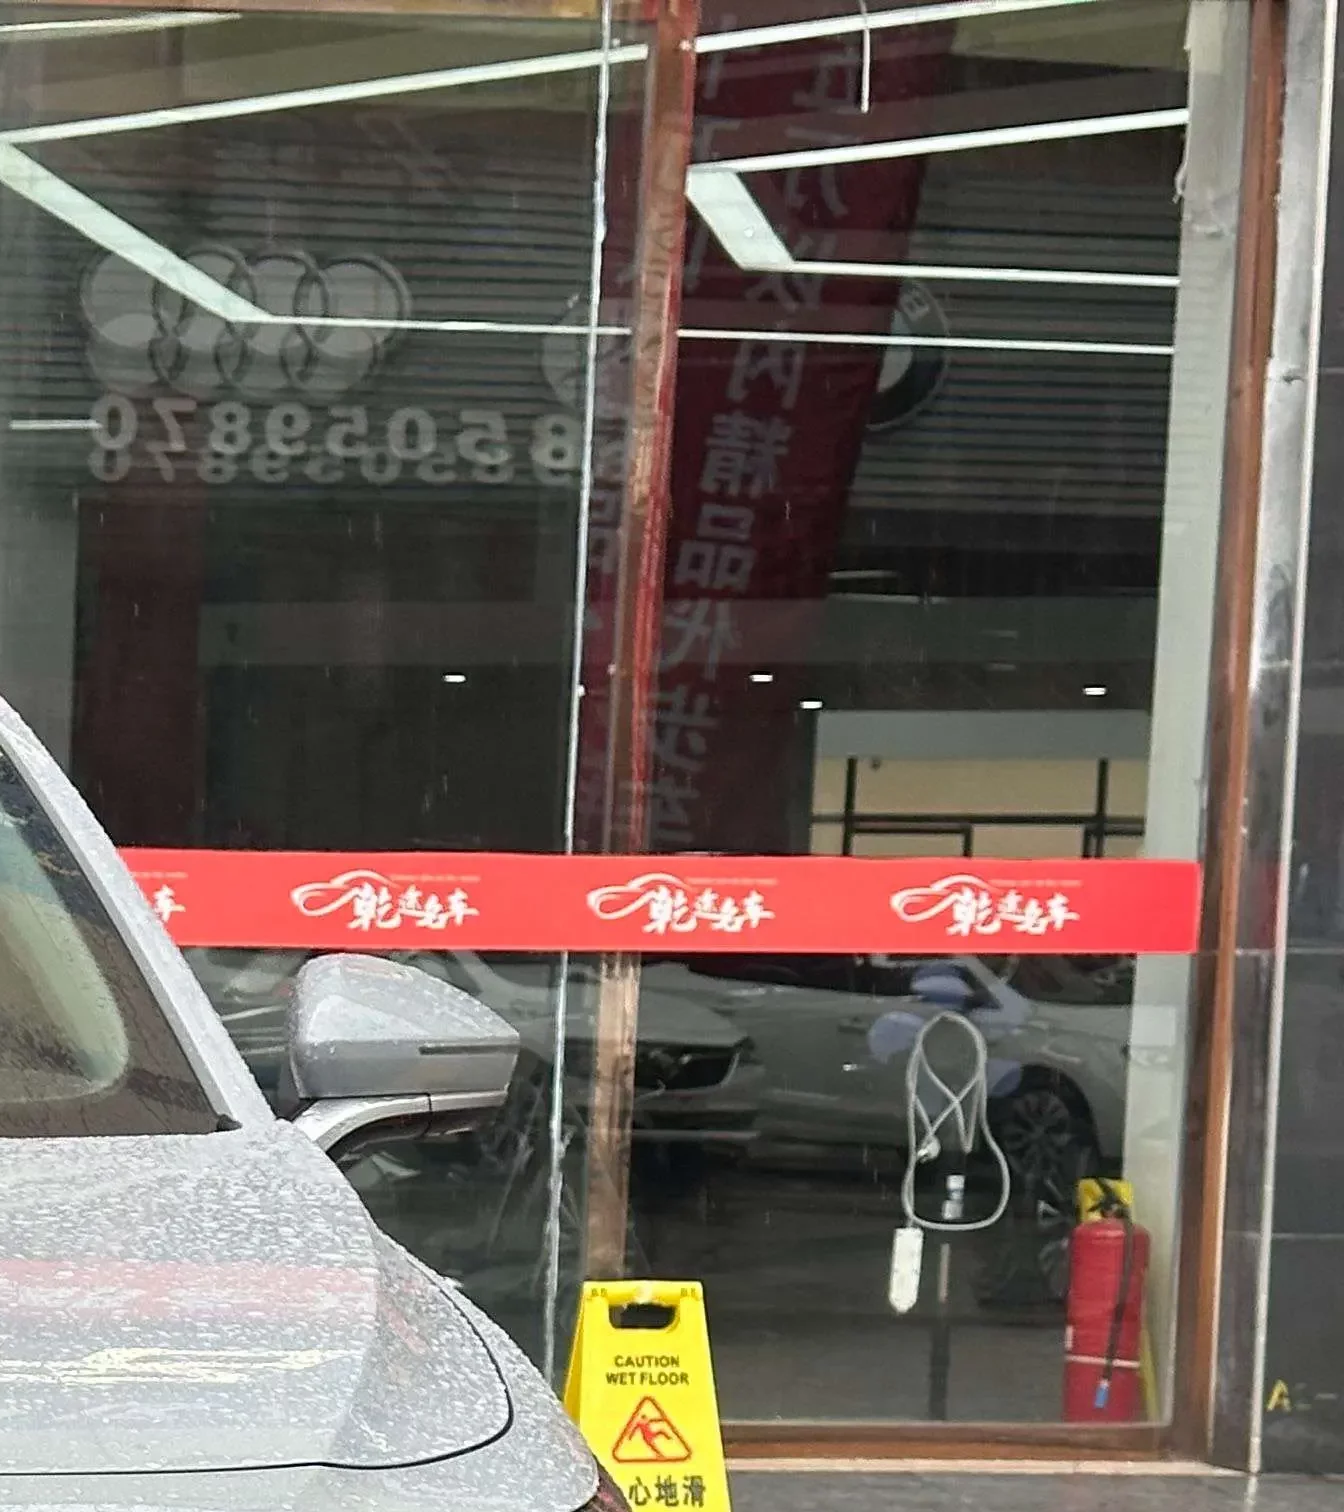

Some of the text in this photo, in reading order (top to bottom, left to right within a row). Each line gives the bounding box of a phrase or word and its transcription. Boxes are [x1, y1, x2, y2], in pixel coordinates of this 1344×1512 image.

[347, 881, 479, 932] 乾途名车
[642, 885, 776, 935] 乾途名车
[946, 886, 1080, 937] 乾途名车
[606, 1372, 690, 1385] WET FLOOR
[614, 1355, 680, 1368] CAUTION
[629, 1474, 707, 1508] 心地滑
